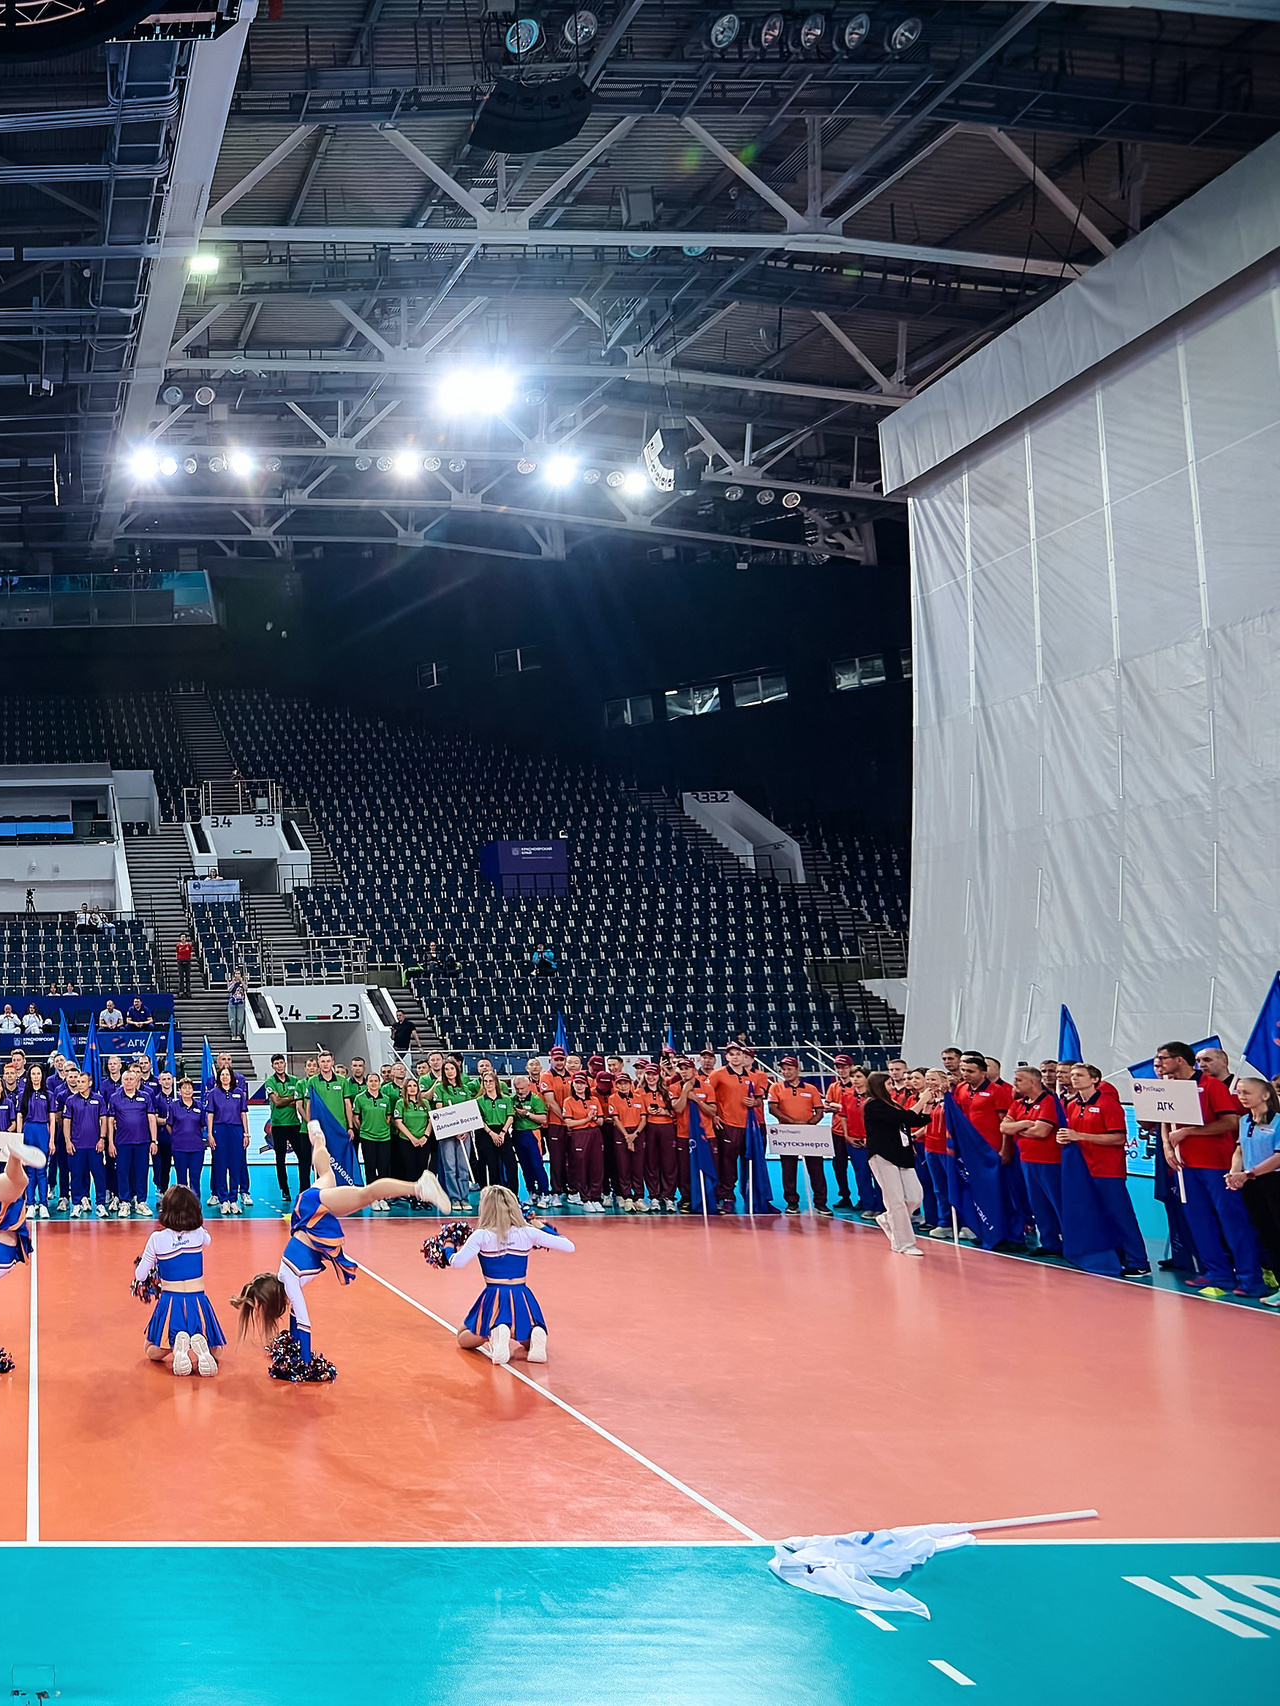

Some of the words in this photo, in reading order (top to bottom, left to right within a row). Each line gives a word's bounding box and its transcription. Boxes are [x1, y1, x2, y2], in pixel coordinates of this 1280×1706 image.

[210, 815, 233, 828] 3.4
[254, 814, 276, 827] 3.3
[274, 1004, 302, 1020] 2.4
[331, 1003, 360, 1020] 2.3
[127, 1039, 146, 1048] ДГК
[1157, 1101, 1175, 1111] ДГК
[436, 1121, 460, 1131] Дальний
[460, 1115, 479, 1124] Восток
[772, 1140, 830, 1149] Якутскэнерго
